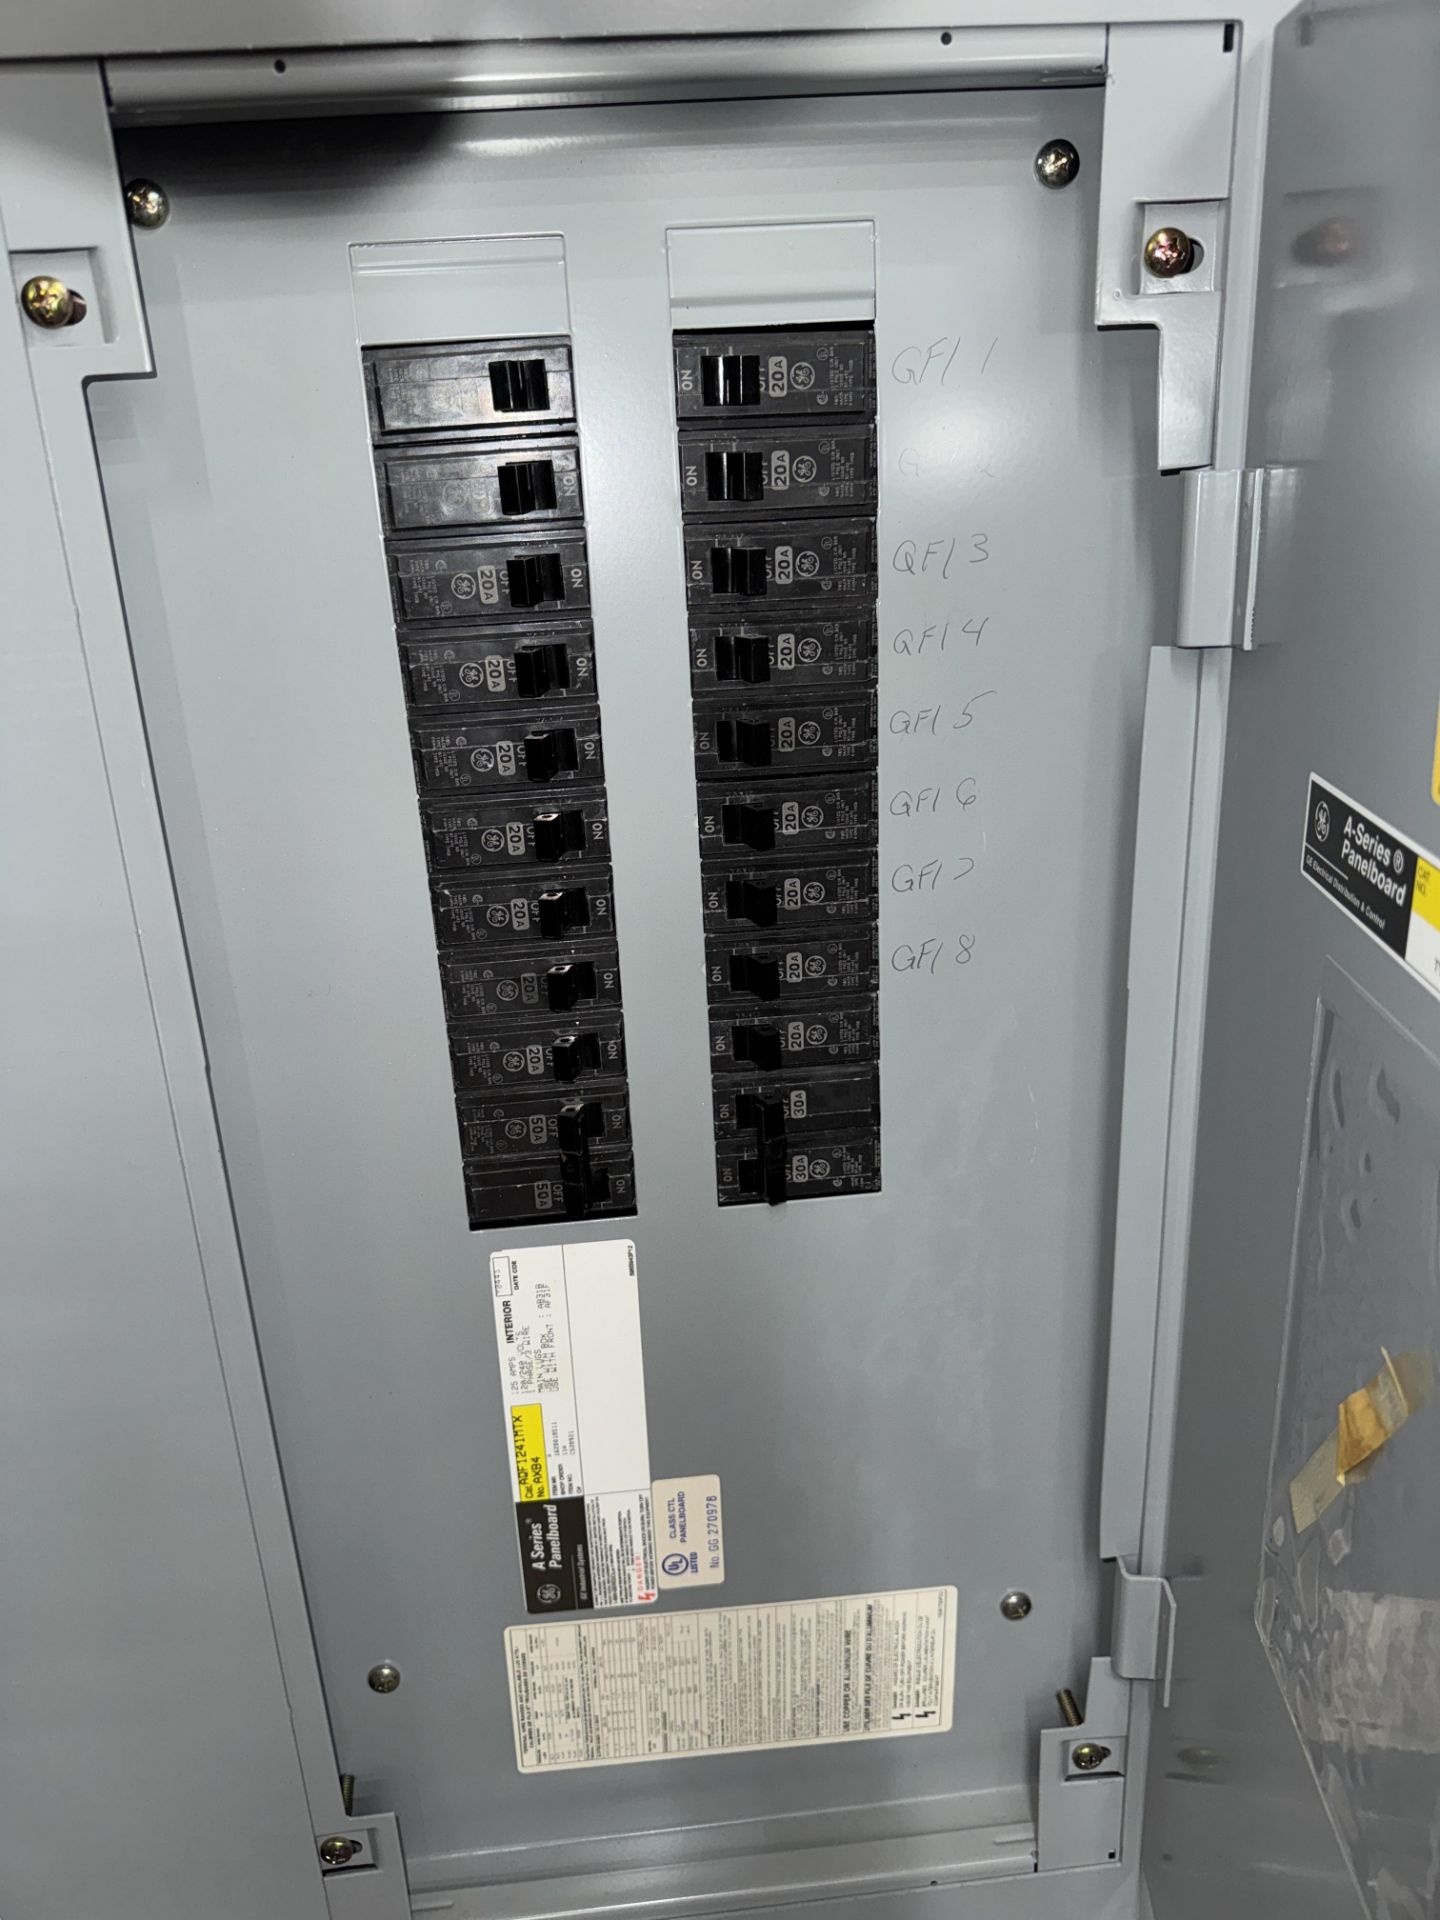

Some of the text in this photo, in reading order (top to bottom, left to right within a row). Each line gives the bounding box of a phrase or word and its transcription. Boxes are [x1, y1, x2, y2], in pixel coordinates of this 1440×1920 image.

[682, 370, 692, 390] ON
[771, 359, 785, 393] 20A
[686, 466, 697, 486] ON
[773, 454, 788, 488] 20A
[563, 476, 576, 496] ON
[969, 533, 989, 562] 3
[691, 560, 702, 580] ON
[777, 549, 792, 581] 20A
[479, 569, 495, 601] 20A
[571, 569, 583, 588] ON
[962, 617, 989, 646] 4
[696, 648, 707, 667] ON
[780, 637, 794, 667] 20A
[487, 659, 502, 690] 20A
[577, 658, 588, 677] ON
[953, 690, 997, 729] 5
[700, 732, 710, 750] ON
[780, 720, 794, 750] 20A
[498, 744, 511, 773] 20A
[584, 742, 595, 760] ON
[956, 778, 976, 811] 6
[704, 816, 715, 833] ON
[784, 804, 798, 832] 20A
[508, 825, 521, 853] 20A
[592, 823, 603, 840] ON
[1344, 816, 1390, 867] A-Series
[953, 858, 974, 880] 7
[1342, 839, 1406, 906] Panelboard
[708, 892, 718, 908] ON
[786, 880, 799, 908] 20A
[1313, 859, 1333, 883] Electrical
[1334, 875, 1360, 904] Distribution
[1366, 904, 1386, 929] Control
[512, 901, 525, 928] 20A
[596, 900, 606, 915] ON
[955, 934, 975, 964] 8
[712, 966, 722, 982] ON
[788, 954, 801, 981] 20A
[522, 975, 535, 1002] 20A
[604, 973, 614, 989] ON
[715, 1036, 725, 1051] ON
[790, 1024, 803, 1050] 20A
[529, 1047, 542, 1073] 20A
[607, 1044, 618, 1059] ON
[720, 1104, 729, 1118] ON
[792, 1092, 805, 1116] 30A
[531, 1117, 544, 1142] 50A
[548, 1119, 558, 1138] OFF
[612, 1114, 622, 1129] ON
[723, 1168, 732, 1182] ON
[794, 1156, 807, 1180] 30A
[536, 1182, 550, 1208] 50A
[553, 1184, 563, 1202] OFF
[616, 1180, 625, 1194] ON
[503, 1300, 514, 1344] INTERIOR
[508, 1356, 517, 1376] AMPS
[531, 1456, 542, 1484] AXB4
[668, 1514, 677, 1539] CLASS
[677, 1491, 688, 1543] PANELBOARD
[528, 1523, 545, 1559] Series
[543, 1503, 562, 1569] Panelboard
[708, 1539, 719, 1551] GG
[576, 1544, 586, 1566] Systems
[690, 1552, 698, 1573] LISTED
